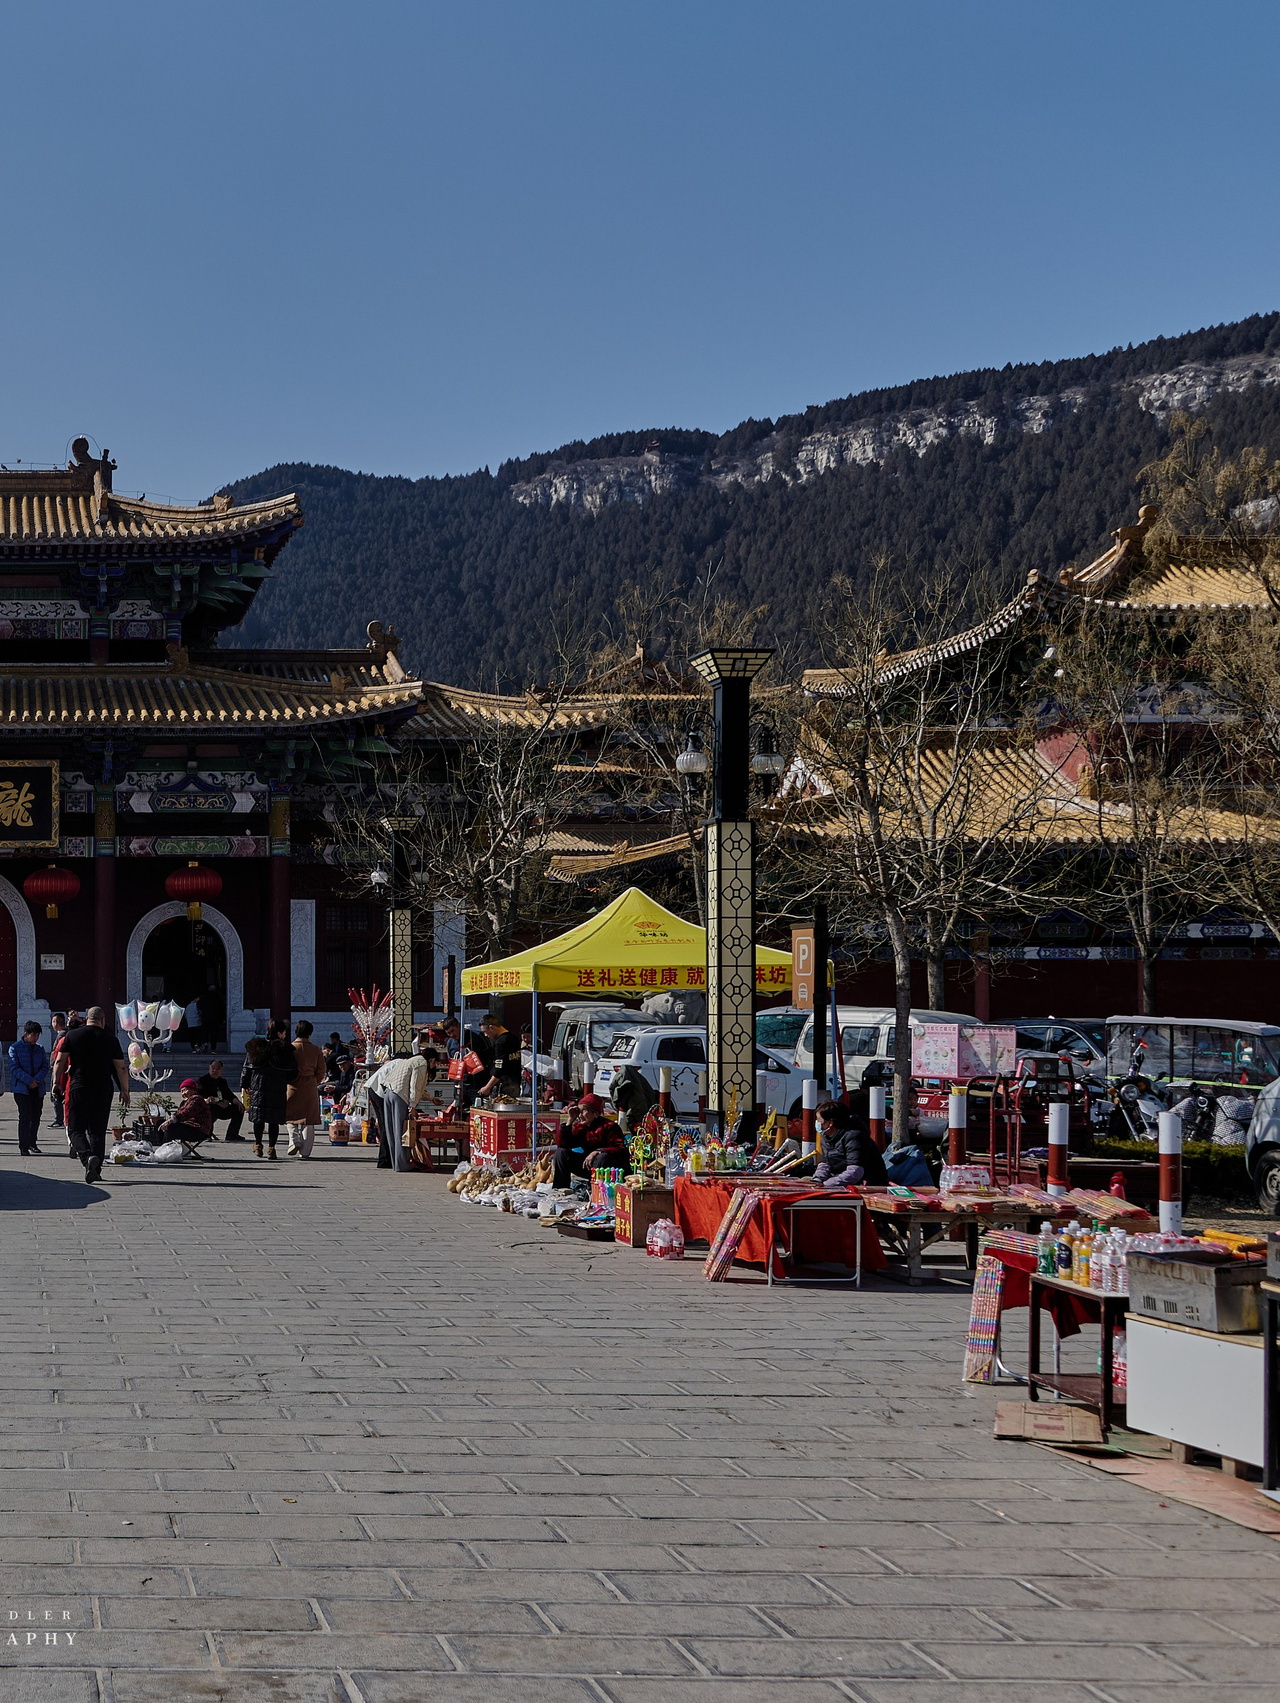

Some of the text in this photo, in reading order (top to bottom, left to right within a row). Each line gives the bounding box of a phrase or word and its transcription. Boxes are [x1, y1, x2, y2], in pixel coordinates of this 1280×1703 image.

[799, 944, 809, 970] P
[577, 967, 679, 987] 送礼送健康
[616, 1192, 630, 1213] 鱼食
